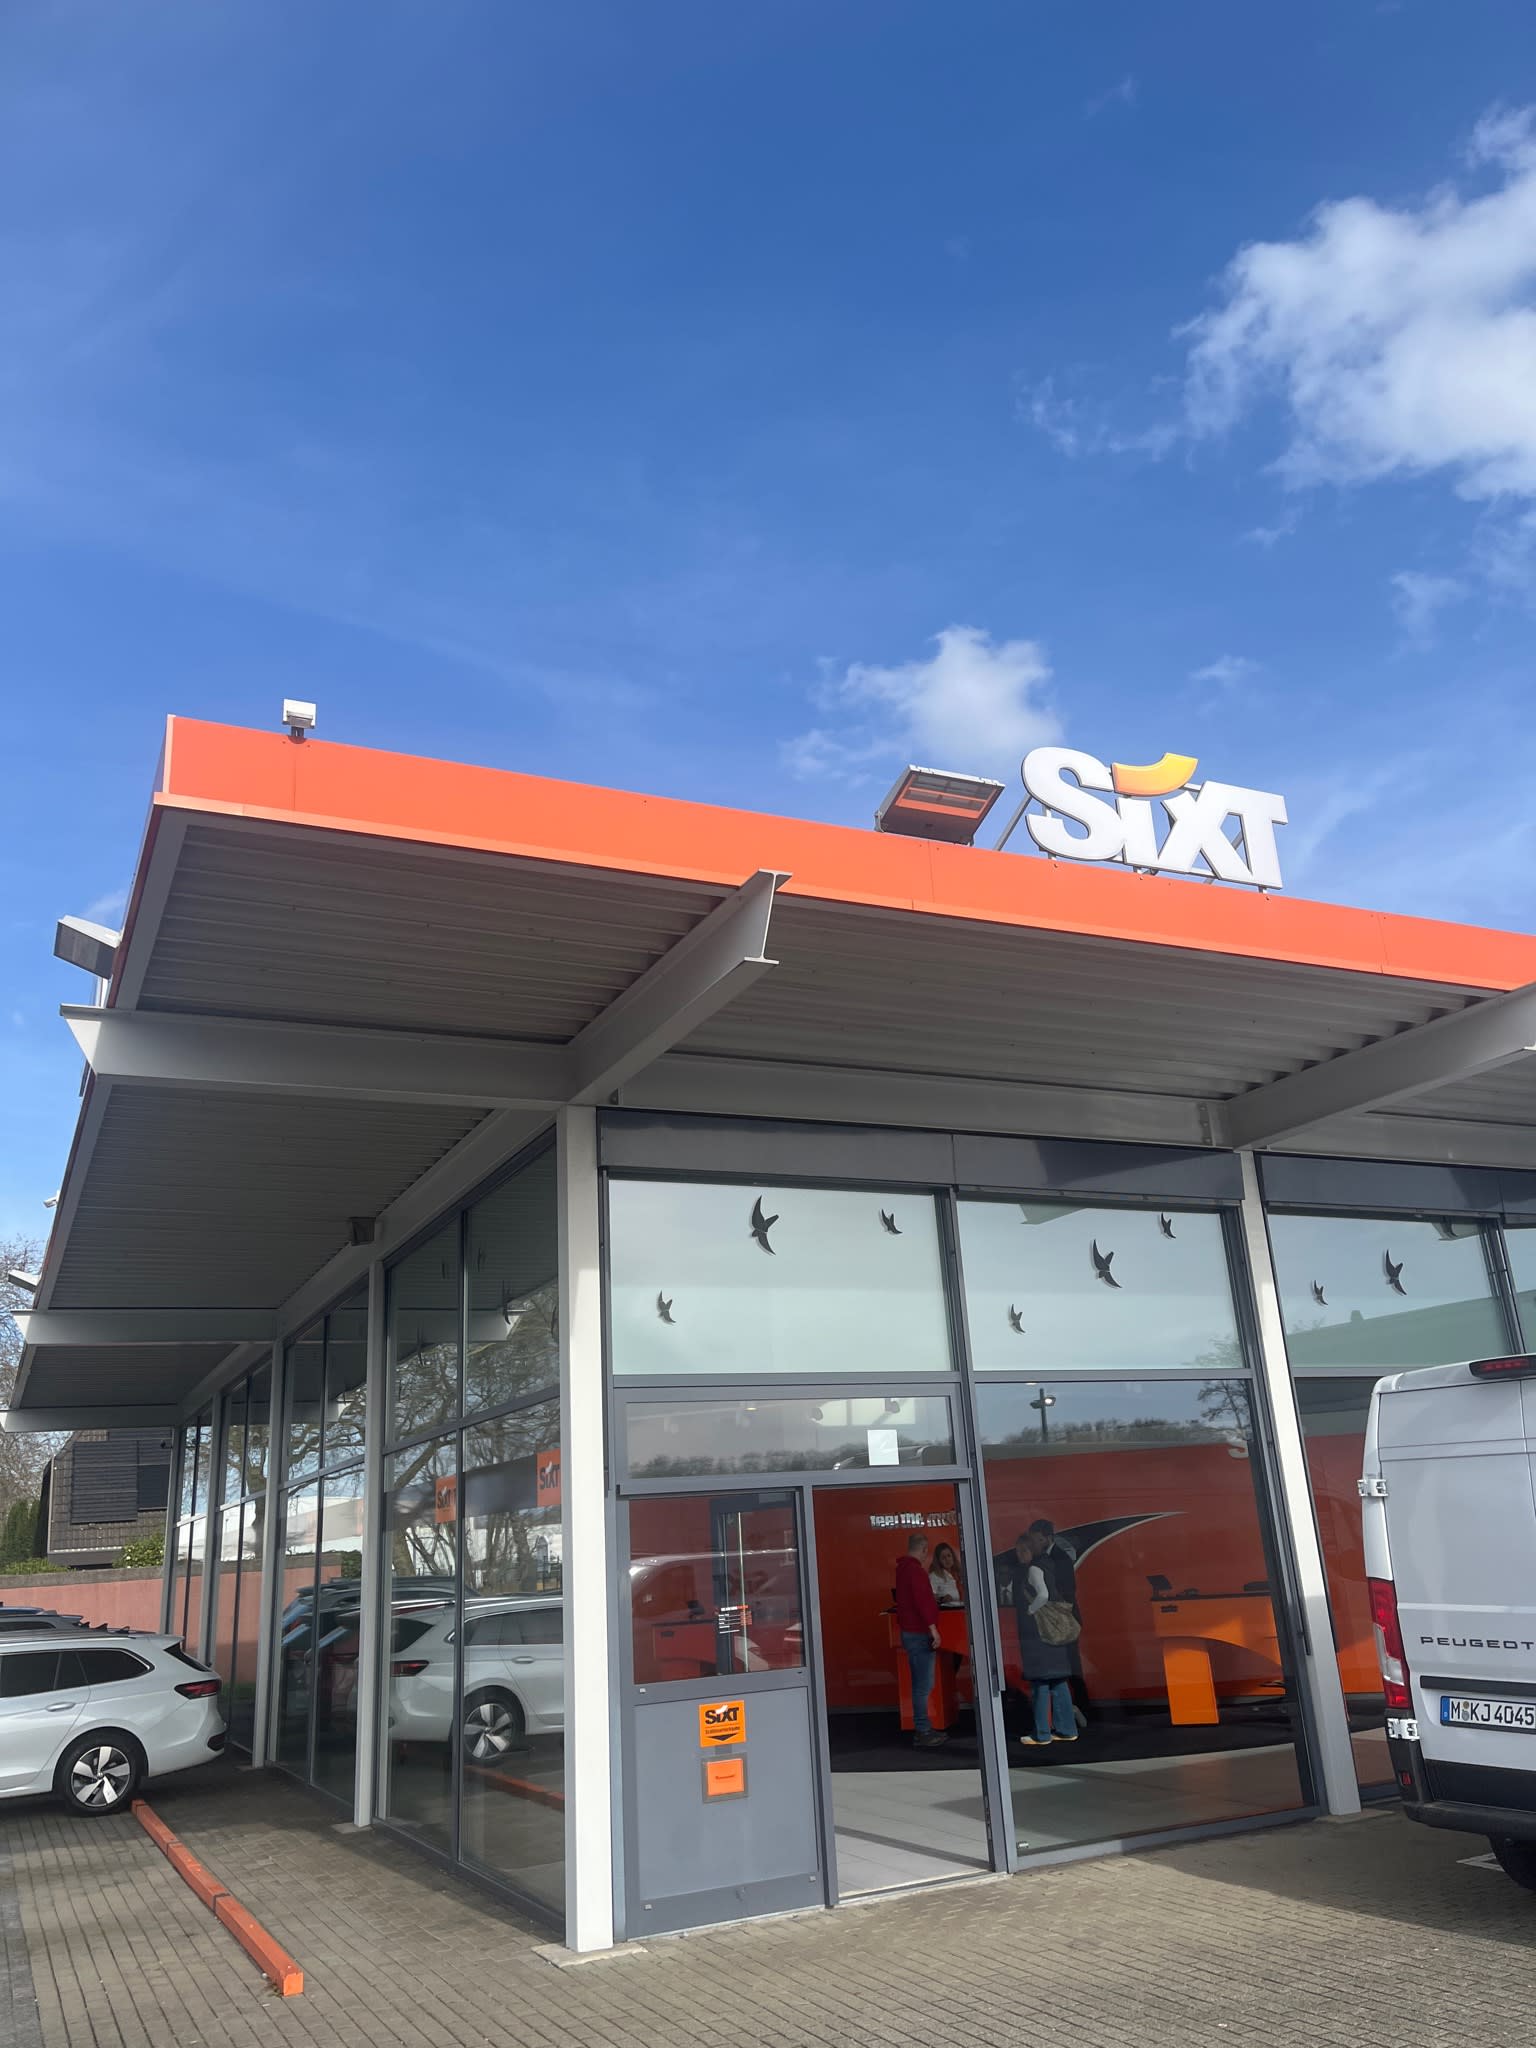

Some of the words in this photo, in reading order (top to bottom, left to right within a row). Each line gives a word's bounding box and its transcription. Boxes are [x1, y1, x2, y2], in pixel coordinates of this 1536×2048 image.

[1420, 1636, 1534, 1650] PEUGEOT
[1451, 1701, 1461, 1720] M
[1494, 1705, 1535, 1726] 4045
